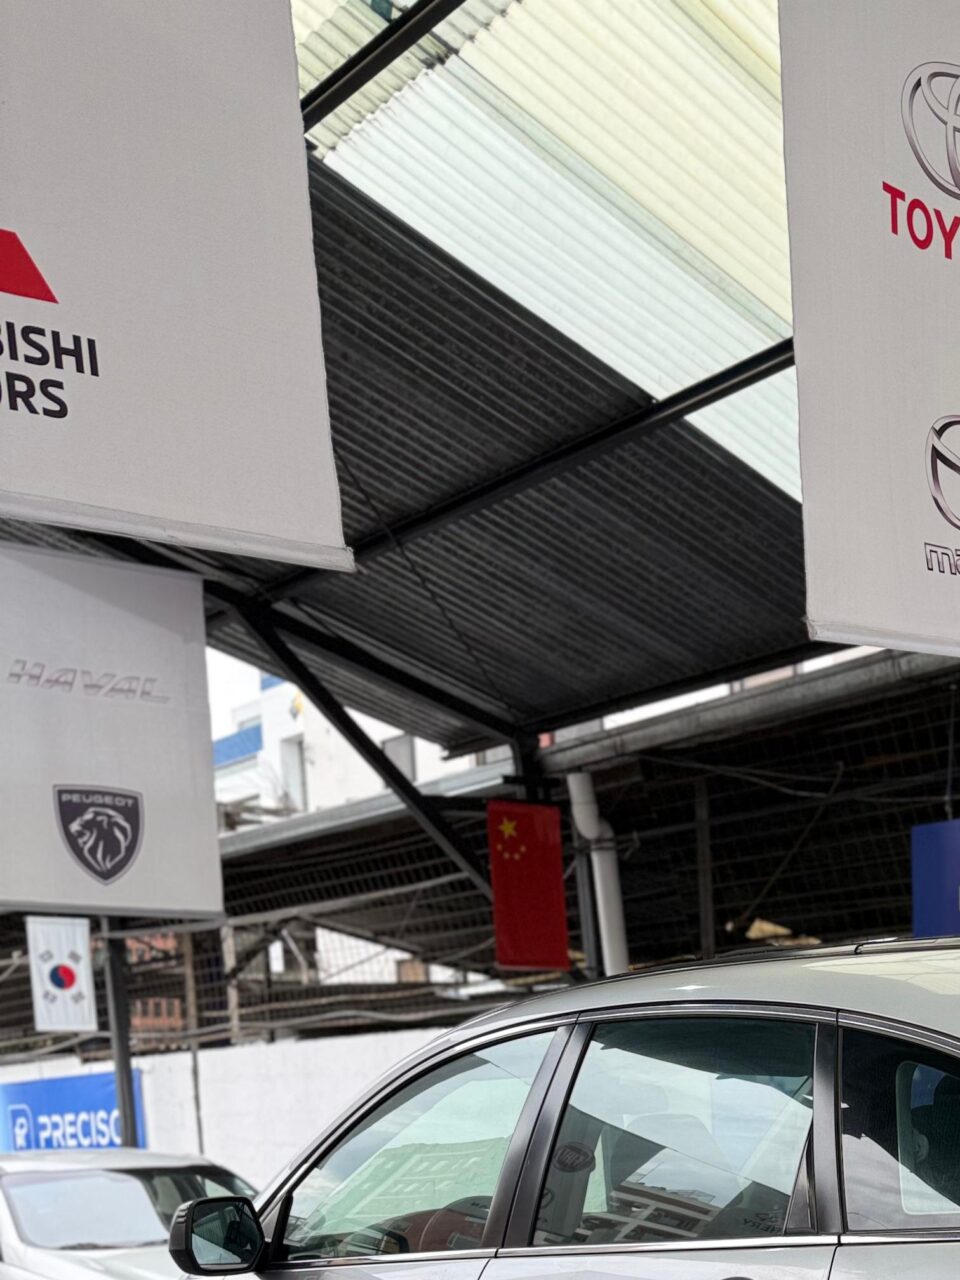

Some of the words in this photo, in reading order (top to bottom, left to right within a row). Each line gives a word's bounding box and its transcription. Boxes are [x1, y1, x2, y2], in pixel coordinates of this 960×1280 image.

[0, 320, 100, 377] ISHI
[0, 371, 69, 419] RS
[7, 658, 171, 704] HAVAL
[61, 792, 135, 808] PEUGEOT
